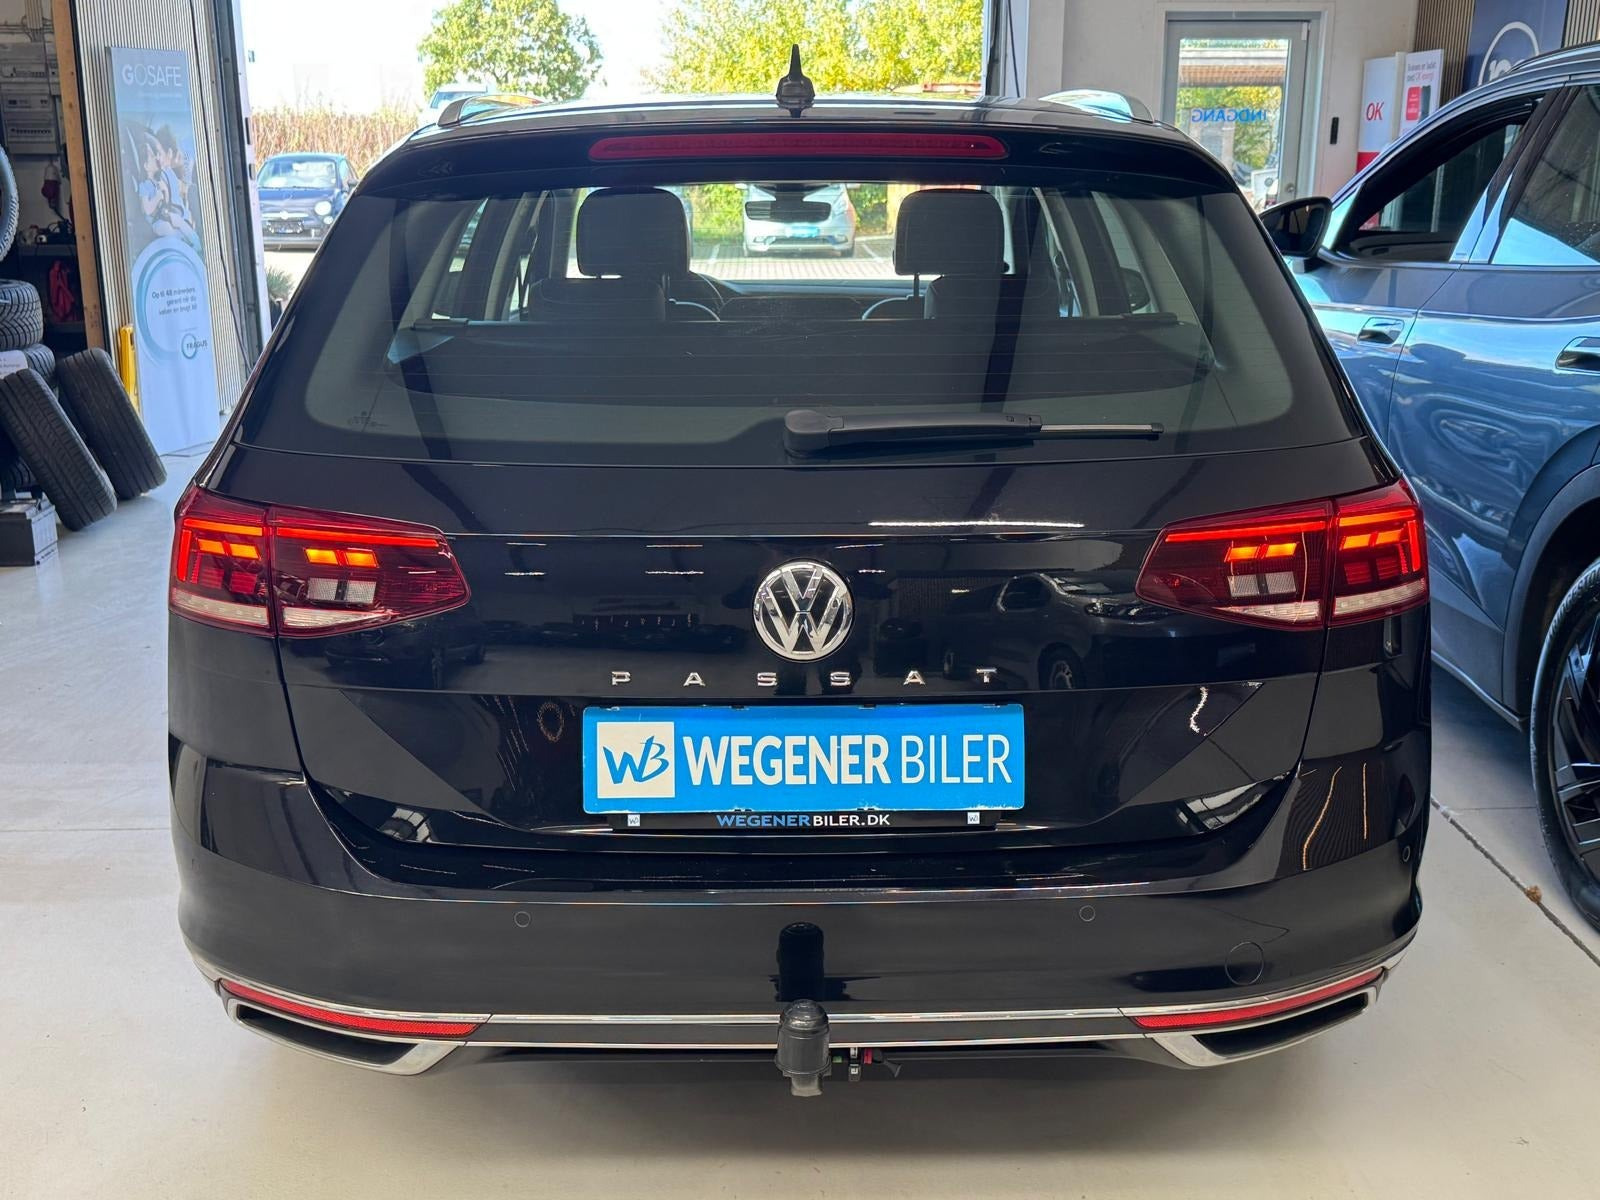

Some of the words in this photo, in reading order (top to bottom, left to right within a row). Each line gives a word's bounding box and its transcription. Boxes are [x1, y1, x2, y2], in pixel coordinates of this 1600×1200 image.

[122, 63, 183, 87] GOSAFE
[1366, 102, 1385, 121] OK
[611, 668, 998, 688] PASSAT
[683, 735, 891, 786] WEGENER
[901, 734, 1013, 784] BILER
[716, 814, 890, 828] WEGENERBILER.DK
